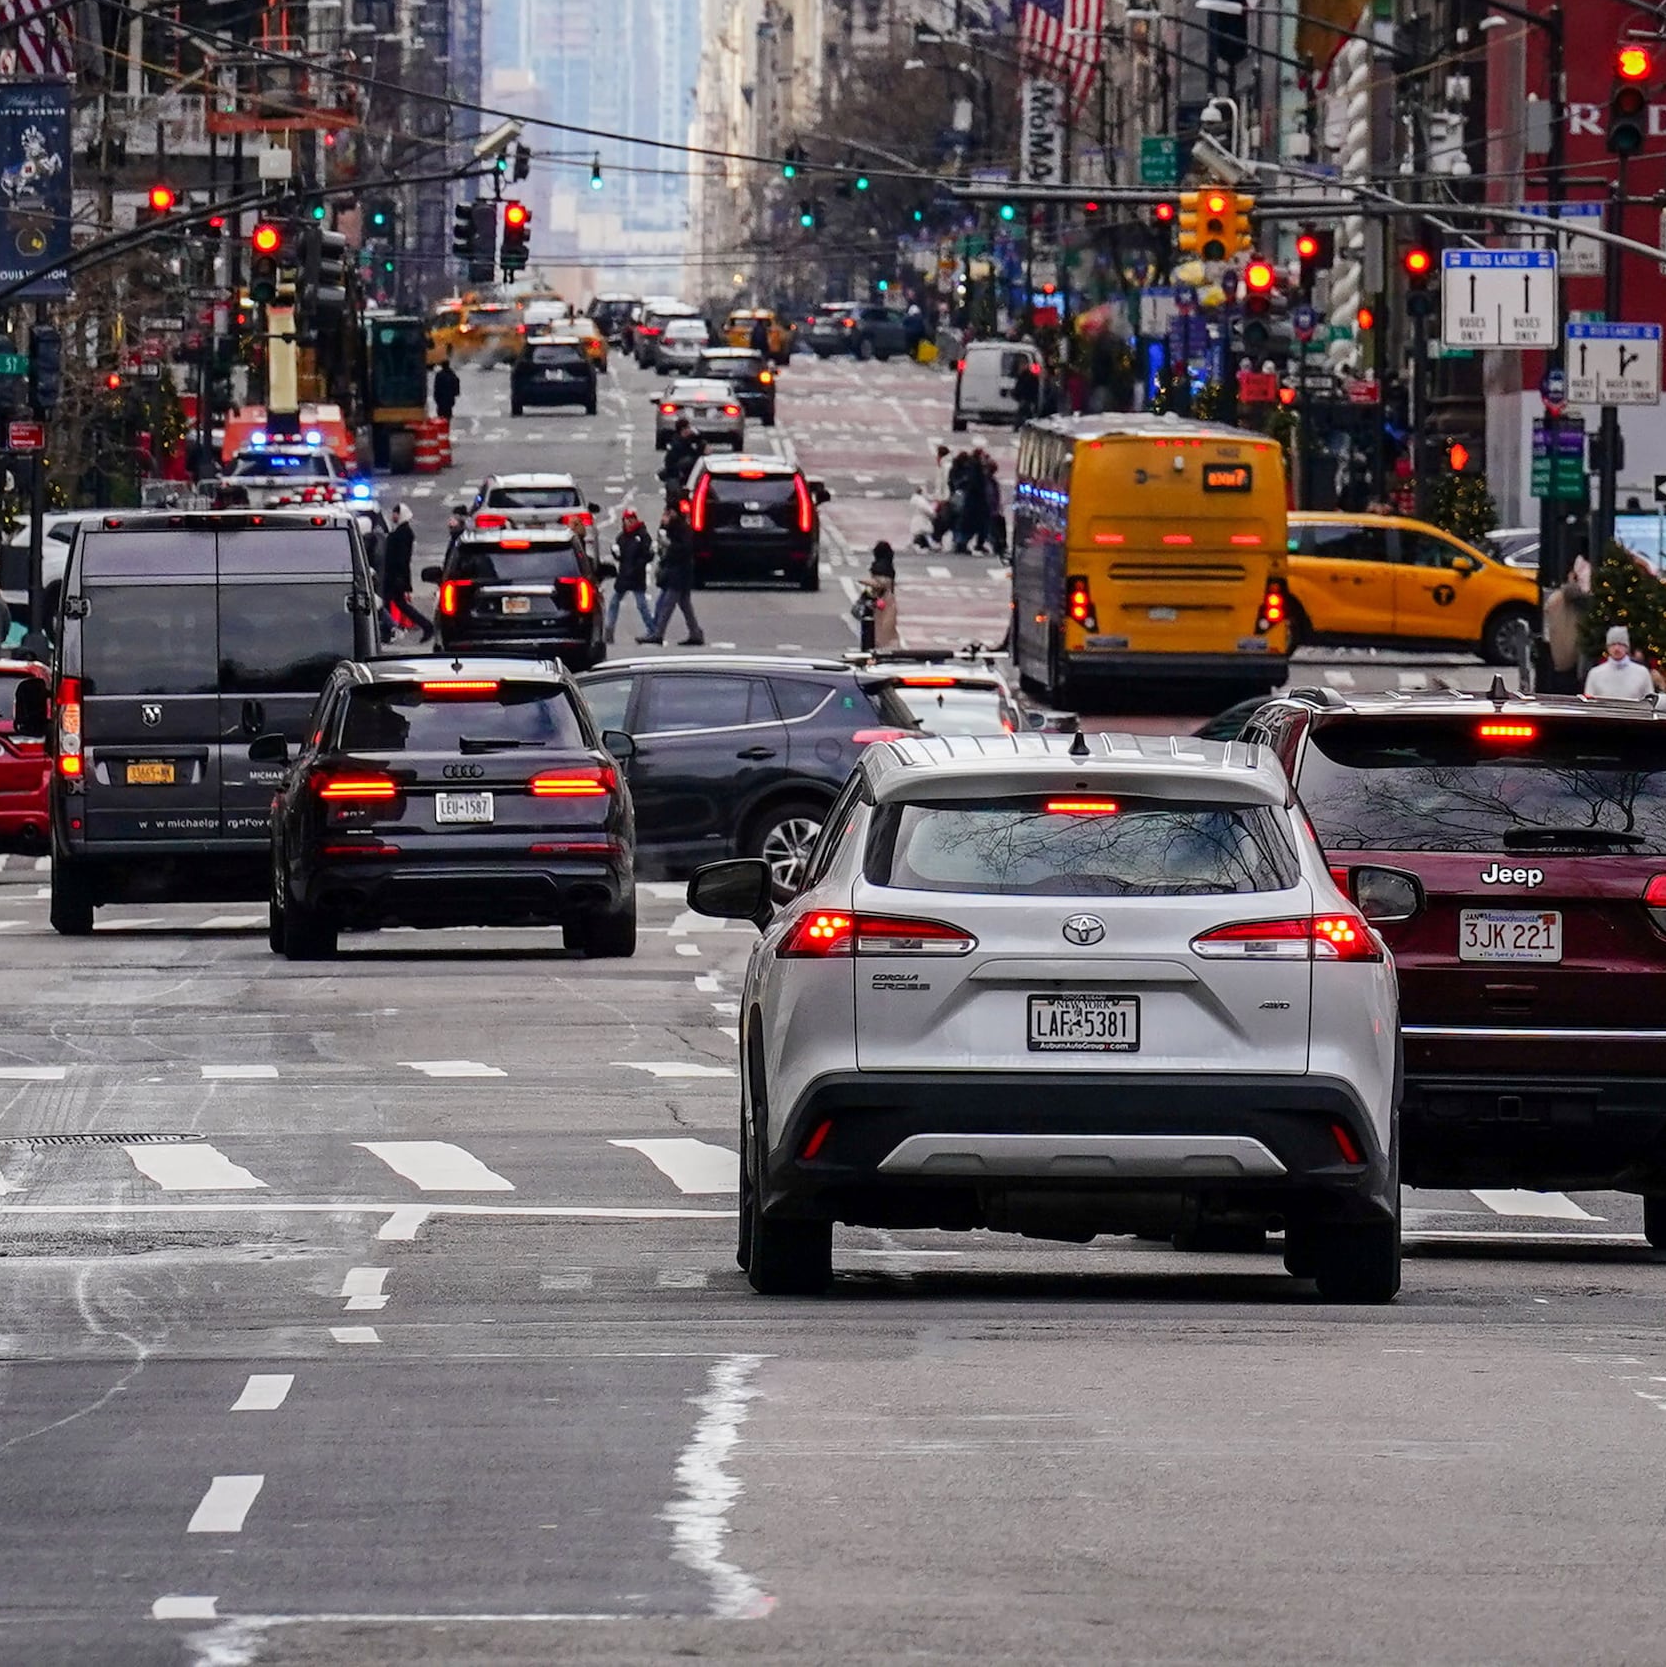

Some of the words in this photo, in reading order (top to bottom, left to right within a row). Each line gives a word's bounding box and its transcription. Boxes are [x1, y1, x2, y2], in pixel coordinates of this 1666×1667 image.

[1030, 86, 1054, 178] MoMA
[1470, 253, 1491, 265] BUS
[1495, 253, 1529, 265] LANES
[1482, 863, 1543, 887] Jeep
[872, 982, 931, 990] CROSS
[1056, 999, 1081, 1009] NEW
[1083, 999, 1110, 1009] YORK
[1085, 1011, 1127, 1037] 5381
